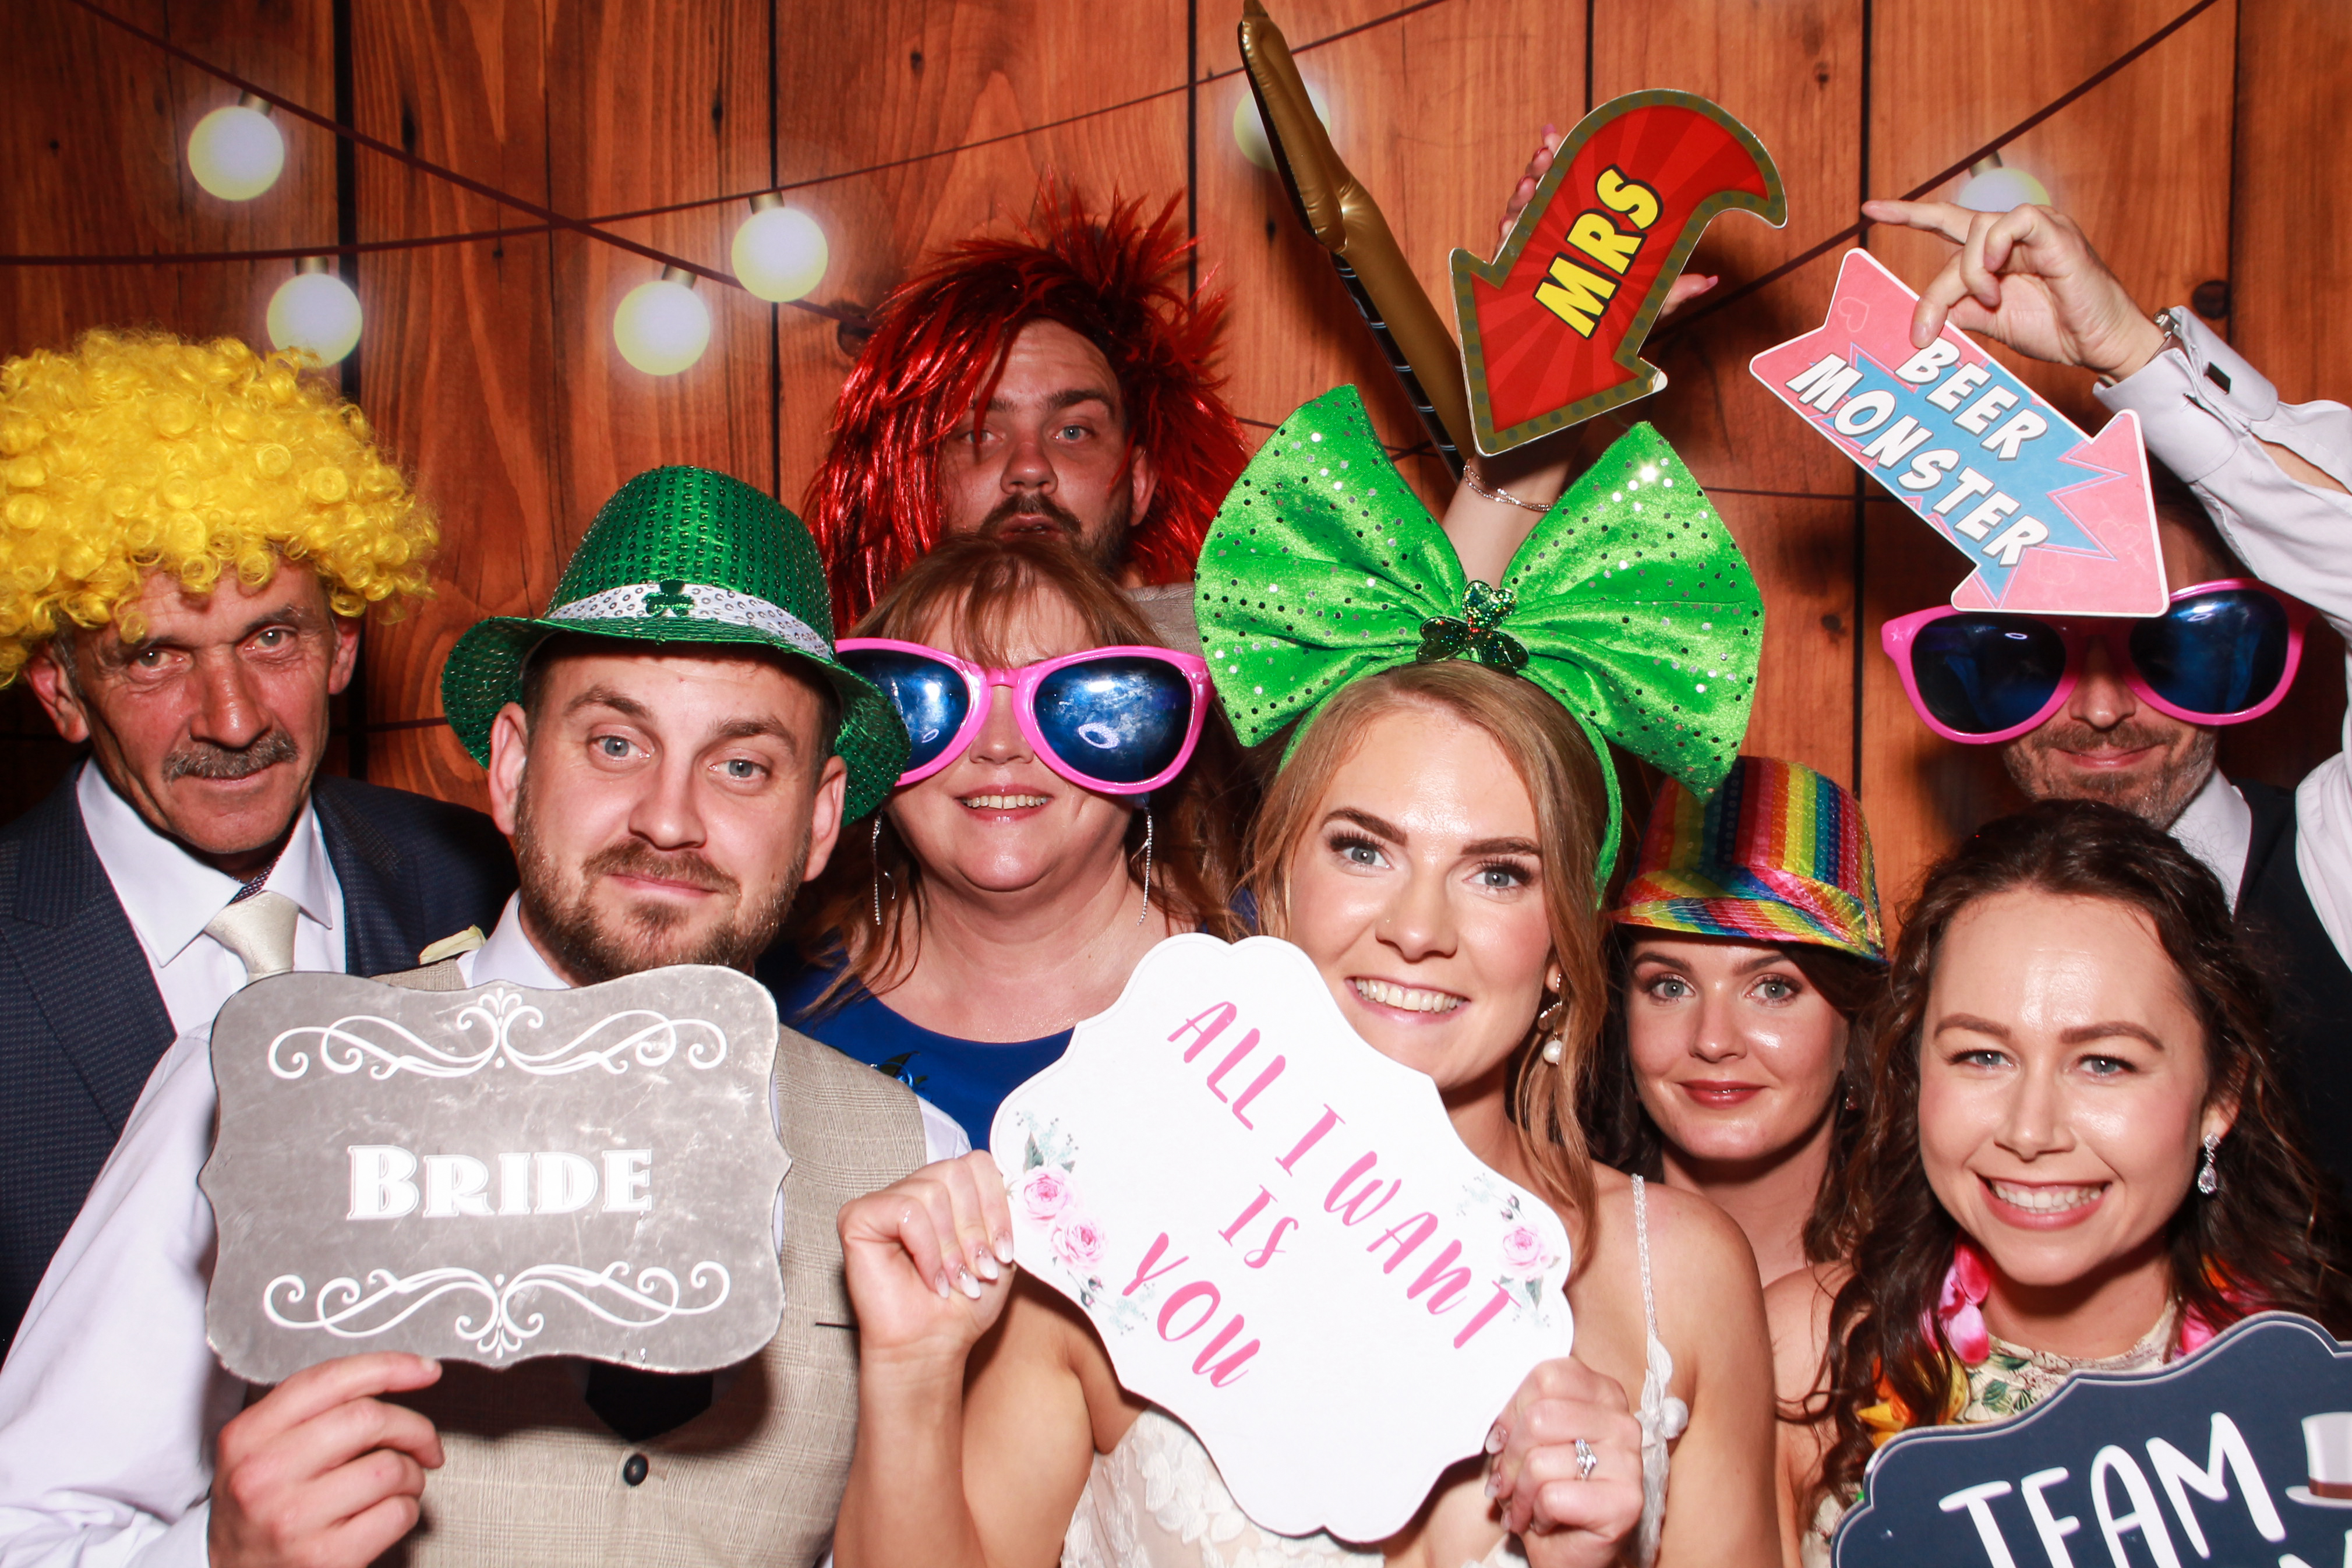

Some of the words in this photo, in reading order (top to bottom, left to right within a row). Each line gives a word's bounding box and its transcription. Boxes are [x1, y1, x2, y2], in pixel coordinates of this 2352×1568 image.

[1535, 168, 1659, 338] MRS
[1785, 354, 2050, 566] MONSTER
[1895, 337, 2049, 459] BEER
[346, 1145, 652, 1220] BRIDE
[1168, 1002, 1286, 1130] ALL
[1275, 1104, 1345, 1177] I
[1324, 1151, 1521, 1349] WANT
[1218, 1185, 1299, 1269] IS
[1122, 1232, 1260, 1388] YOU
[1938, 1412, 2286, 1567] TEAM
